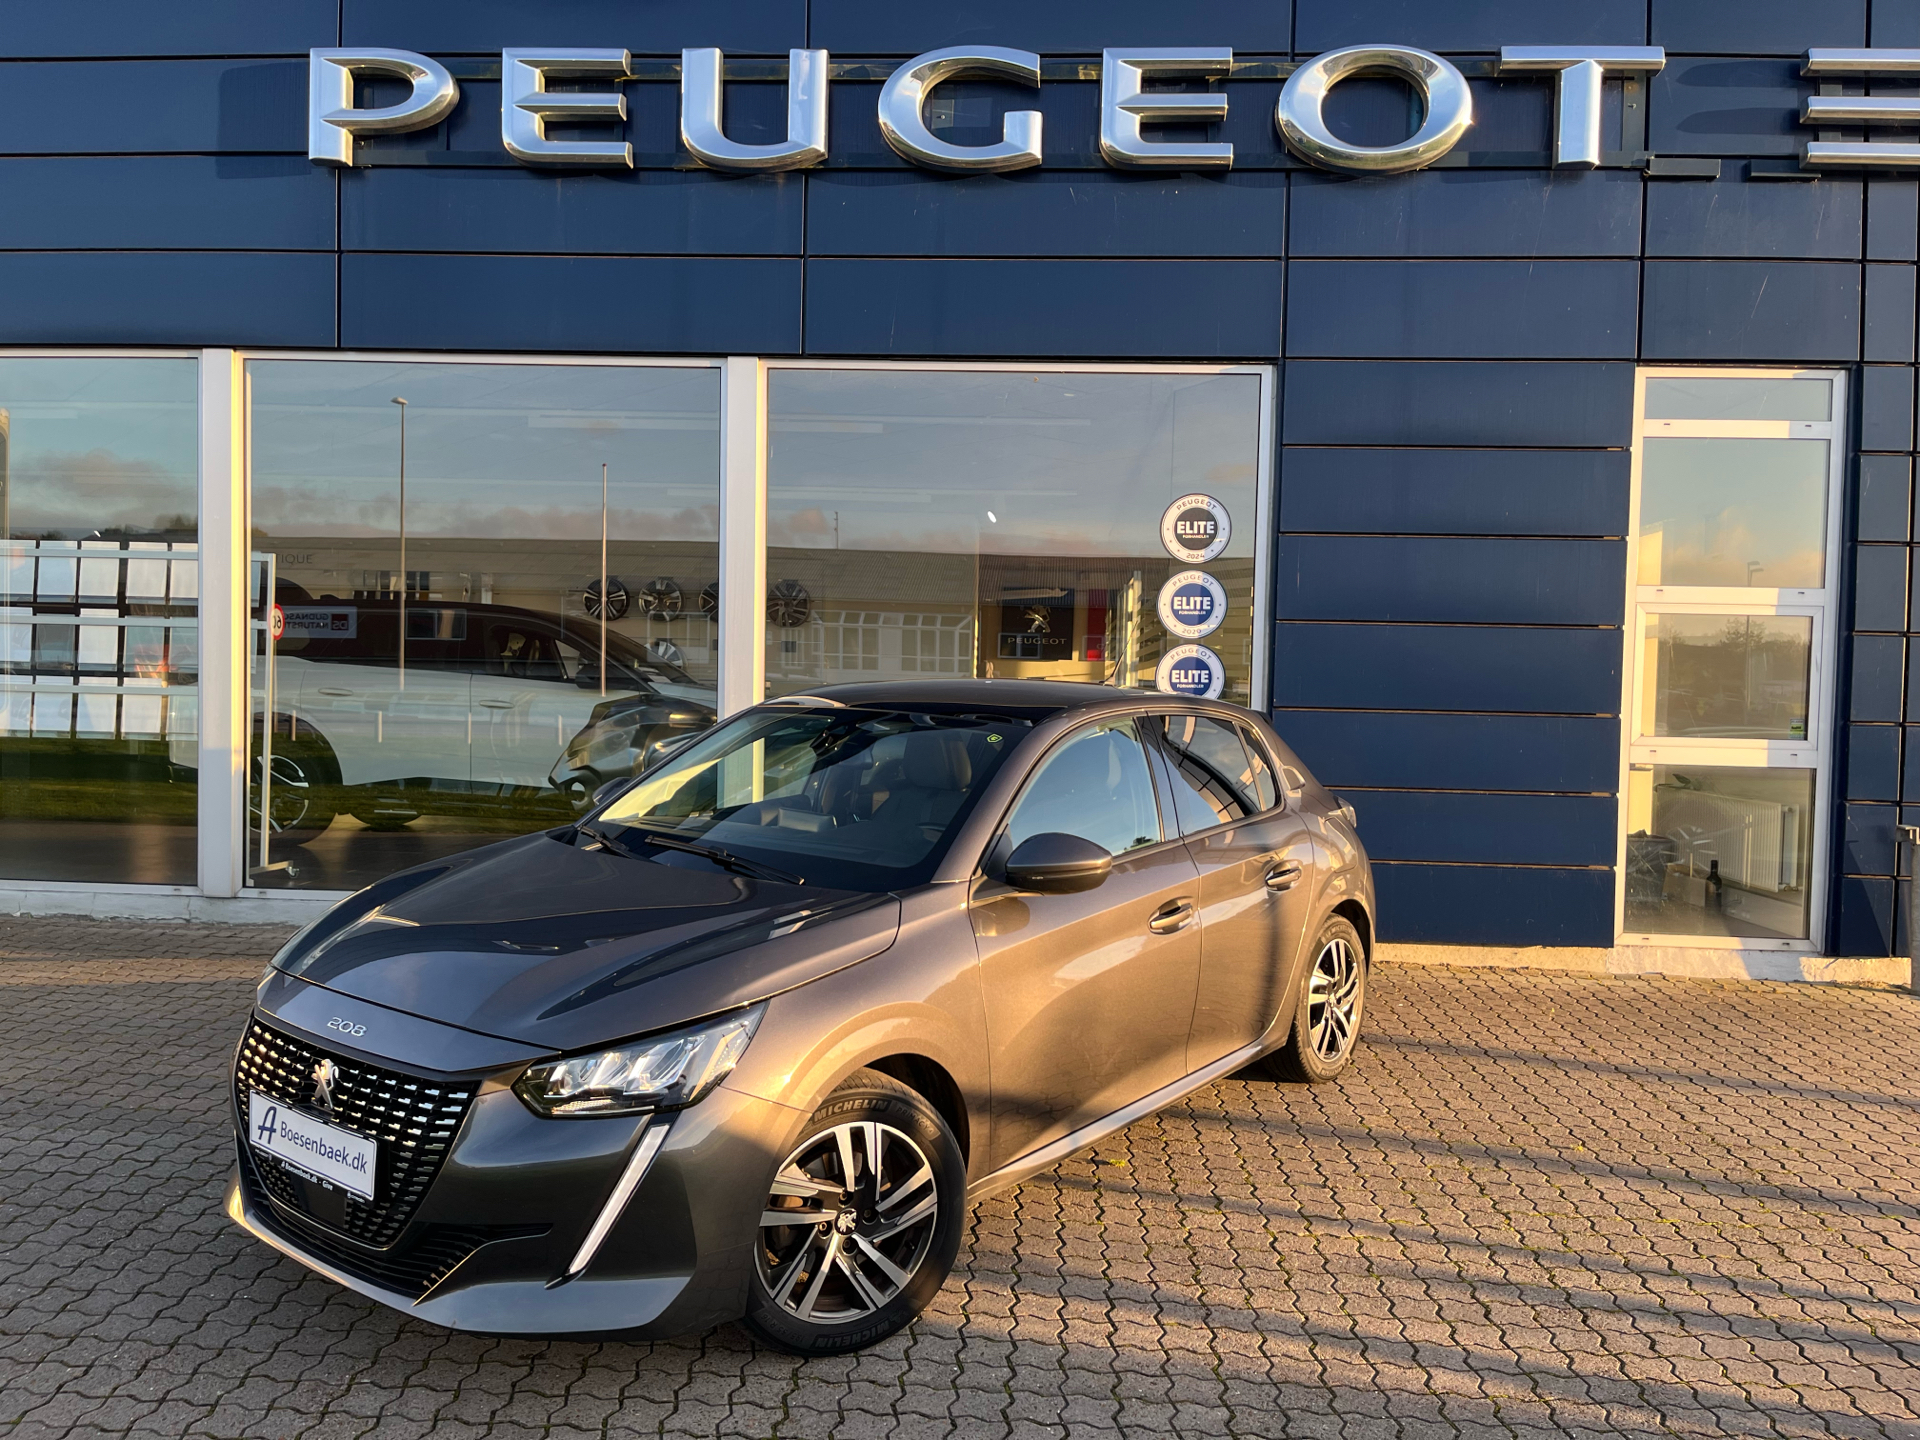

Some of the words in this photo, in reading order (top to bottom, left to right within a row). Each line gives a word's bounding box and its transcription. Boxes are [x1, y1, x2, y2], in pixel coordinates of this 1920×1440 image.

[308, 44, 1666, 175] PEUGEOT
[1176, 498, 1217, 511] PEUGEOT
[1176, 521, 1215, 534] ELITE
[1186, 552, 1205, 560] 2024
[1172, 574, 1214, 588] PEUGEOT
[1173, 596, 1211, 610] ELITE
[1007, 637, 1067, 645] PEUGEOT
[1170, 648, 1214, 660] PEUGEOT
[1171, 669, 1209, 683] ELITE
[326, 1016, 368, 1037] 208
[813, 1099, 890, 1122] MICHELIN
[896, 1106, 930, 1131] PRIMACY
[280, 1121, 368, 1175] Boesenbaek.dk
[815, 1320, 890, 1348] MICHELIN
